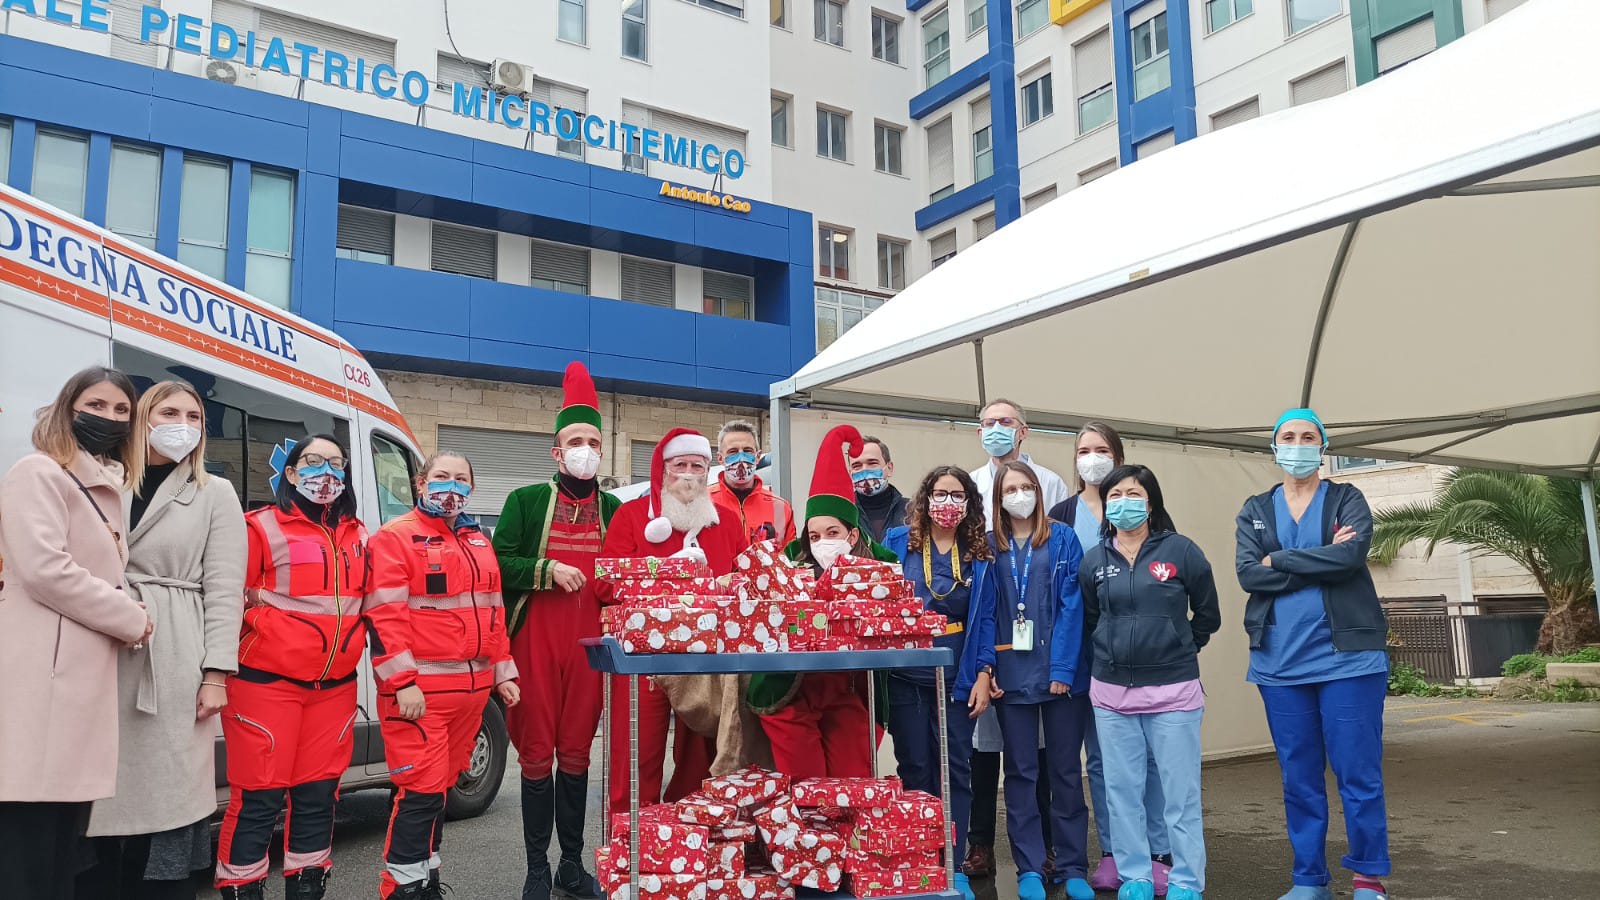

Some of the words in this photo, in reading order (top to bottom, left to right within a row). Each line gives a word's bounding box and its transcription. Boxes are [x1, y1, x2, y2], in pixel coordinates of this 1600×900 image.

[140, 4, 429, 107] PEDIATRICO
[452, 82, 745, 180] MICROCITEMICO
[659, 181, 721, 206] Antonio
[722, 194, 752, 213] Cao
[158, 277, 298, 362] SOCIALE
